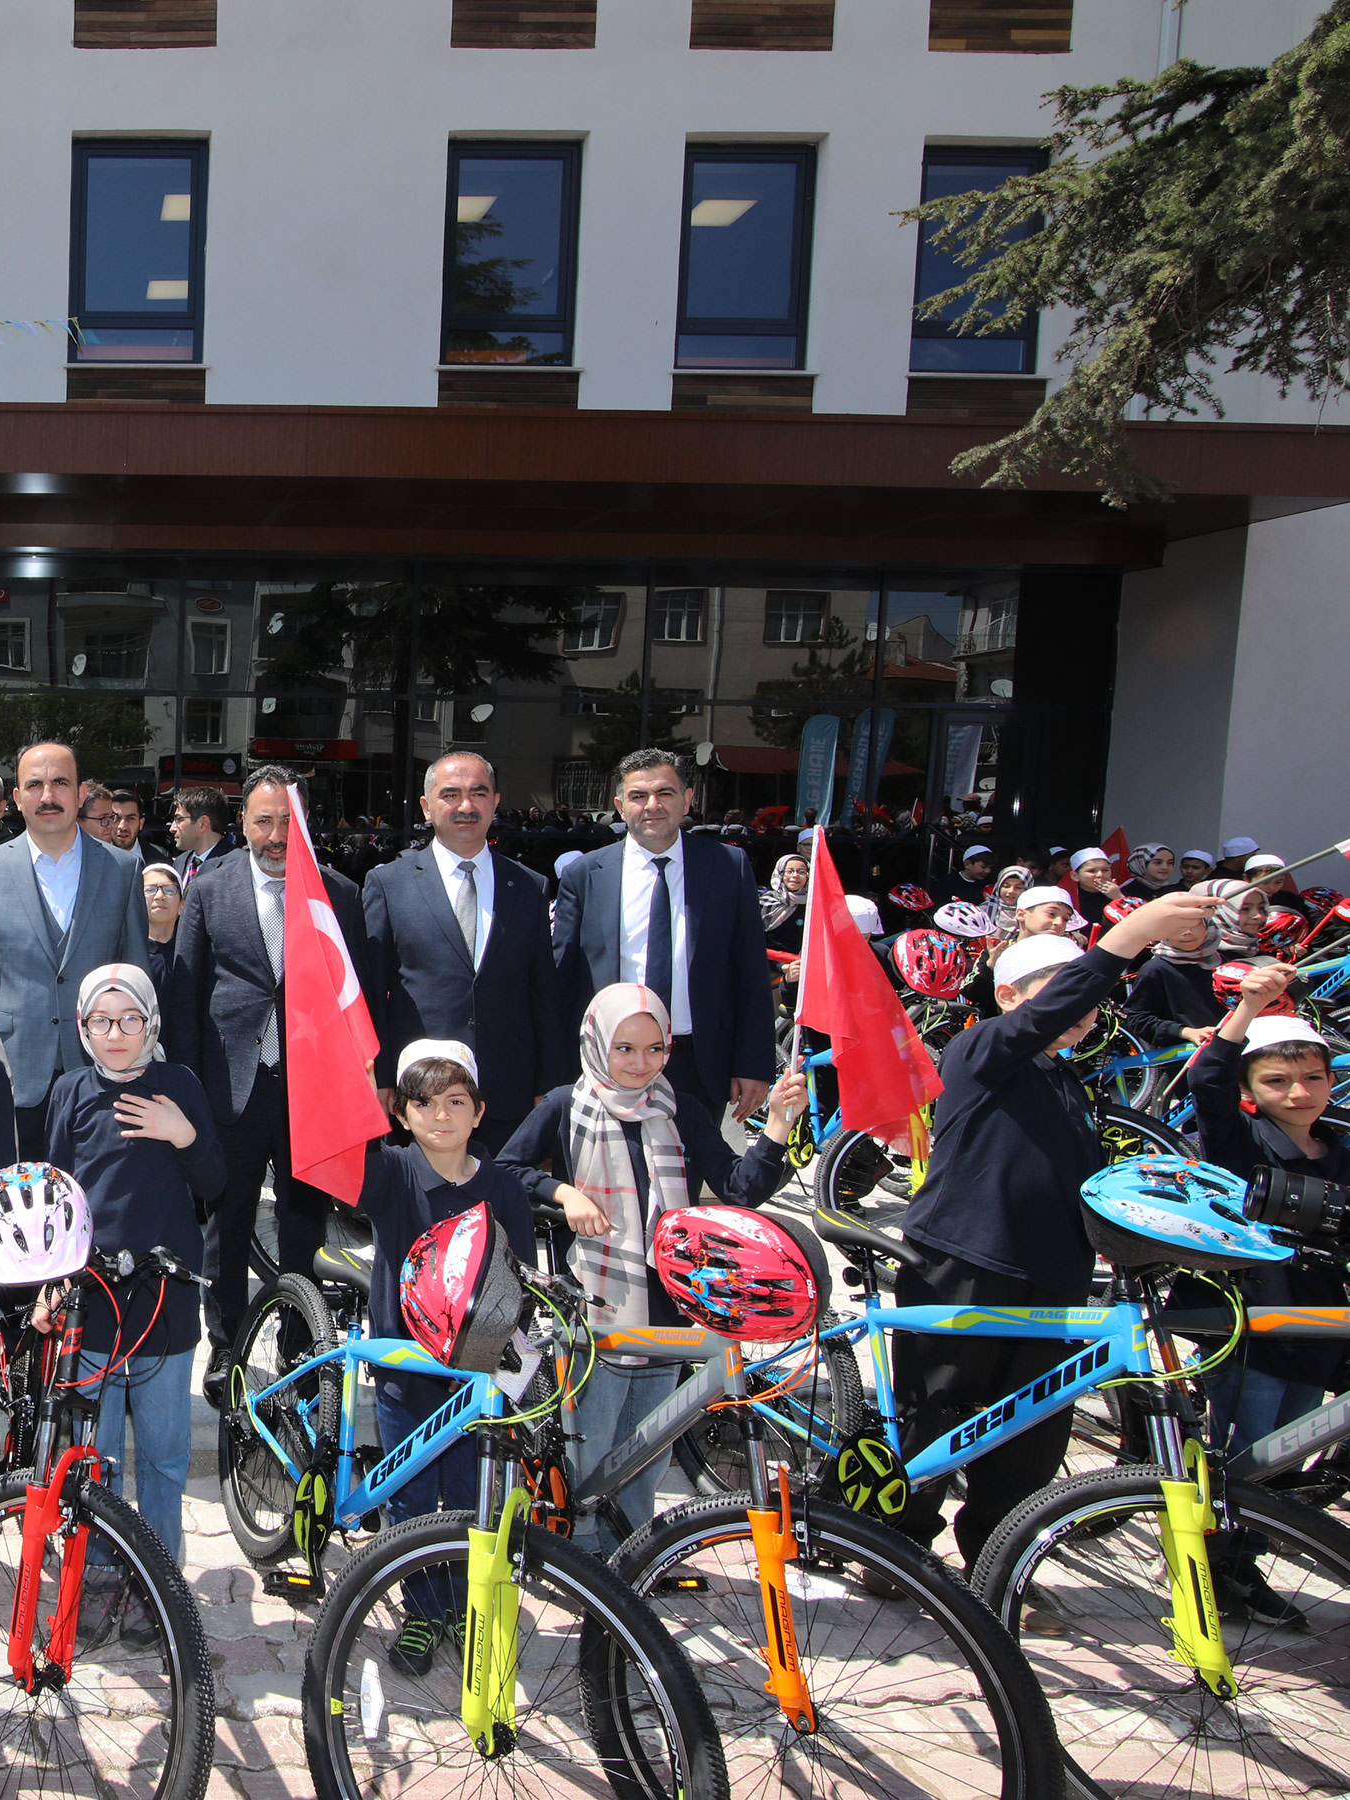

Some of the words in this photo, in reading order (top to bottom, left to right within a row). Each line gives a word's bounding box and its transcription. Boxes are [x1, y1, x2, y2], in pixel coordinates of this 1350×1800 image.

[653, 1331, 704, 1342] MAGNUM
[1029, 1310, 1103, 1320] MAGNUM
[1016, 1524, 1072, 1595] GERONI
[17, 1563, 32, 1641] MAGNUM
[778, 1589, 796, 1673] MAGNUM
[1198, 1562, 1218, 1642] MAGNUM
[474, 1613, 485, 1696] MAGNUM
